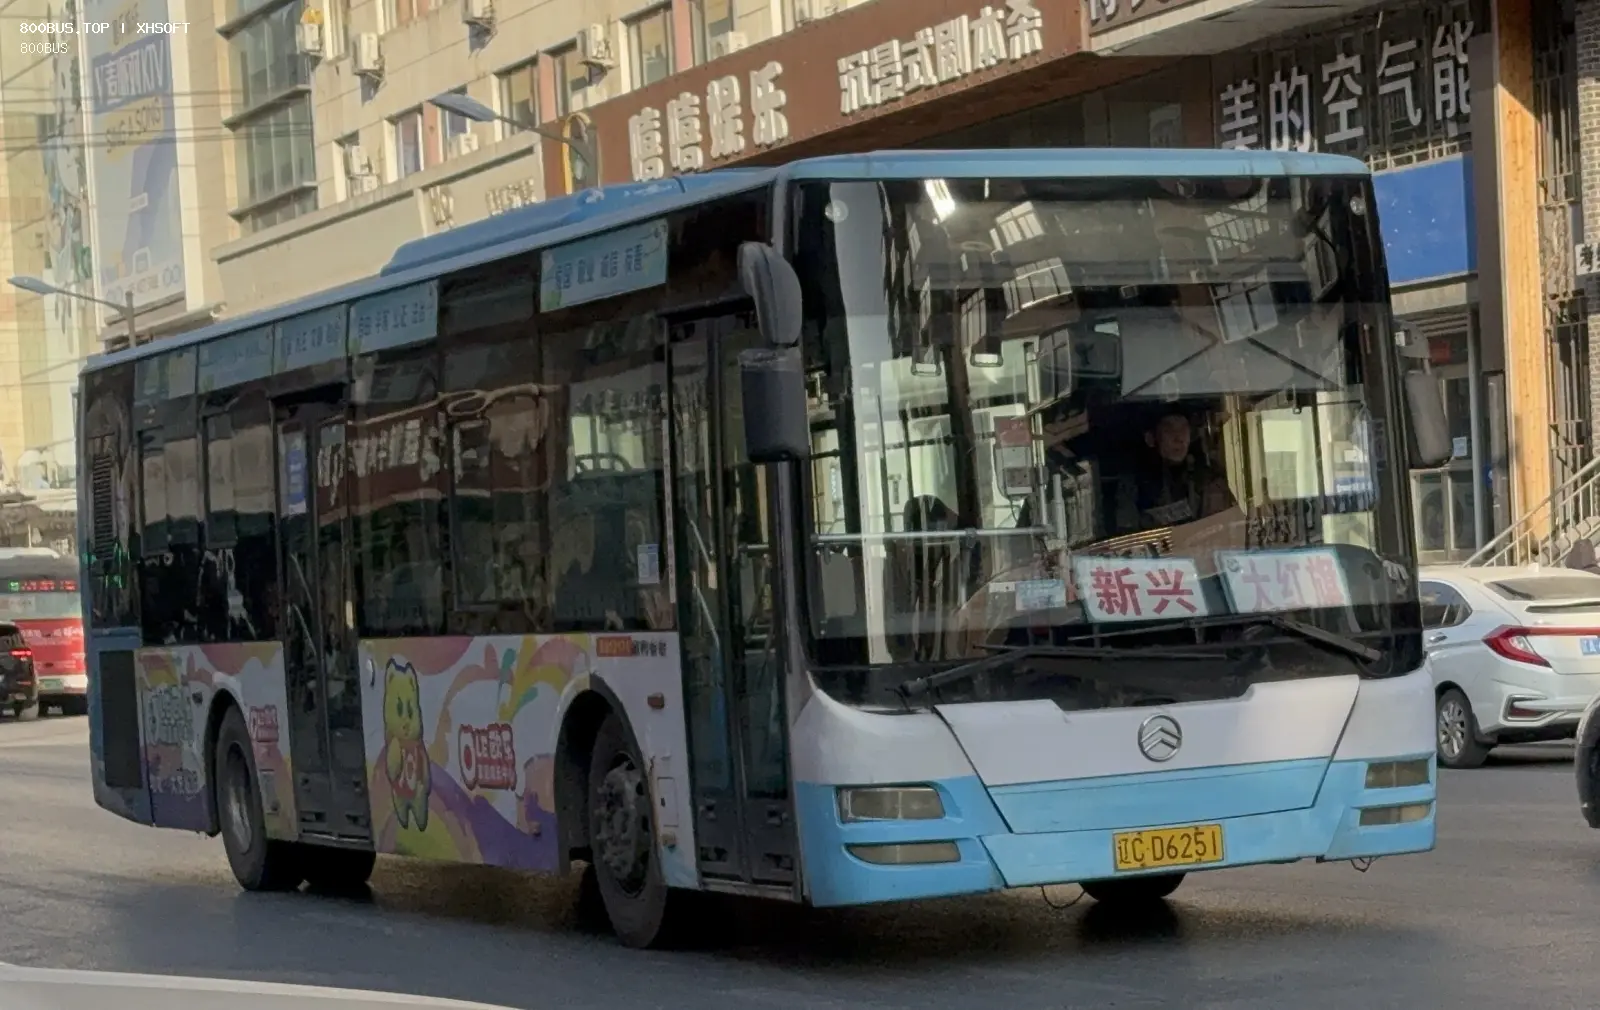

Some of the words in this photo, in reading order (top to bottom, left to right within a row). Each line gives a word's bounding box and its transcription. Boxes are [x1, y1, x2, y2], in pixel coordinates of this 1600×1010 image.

[837, 0, 1044, 114] 沉浸式剧本杀
[1220, 21, 1475, 152] 美的空气能
[1090, 565, 1198, 616] 新兴
[1241, 556, 1344, 612] 大红旗
